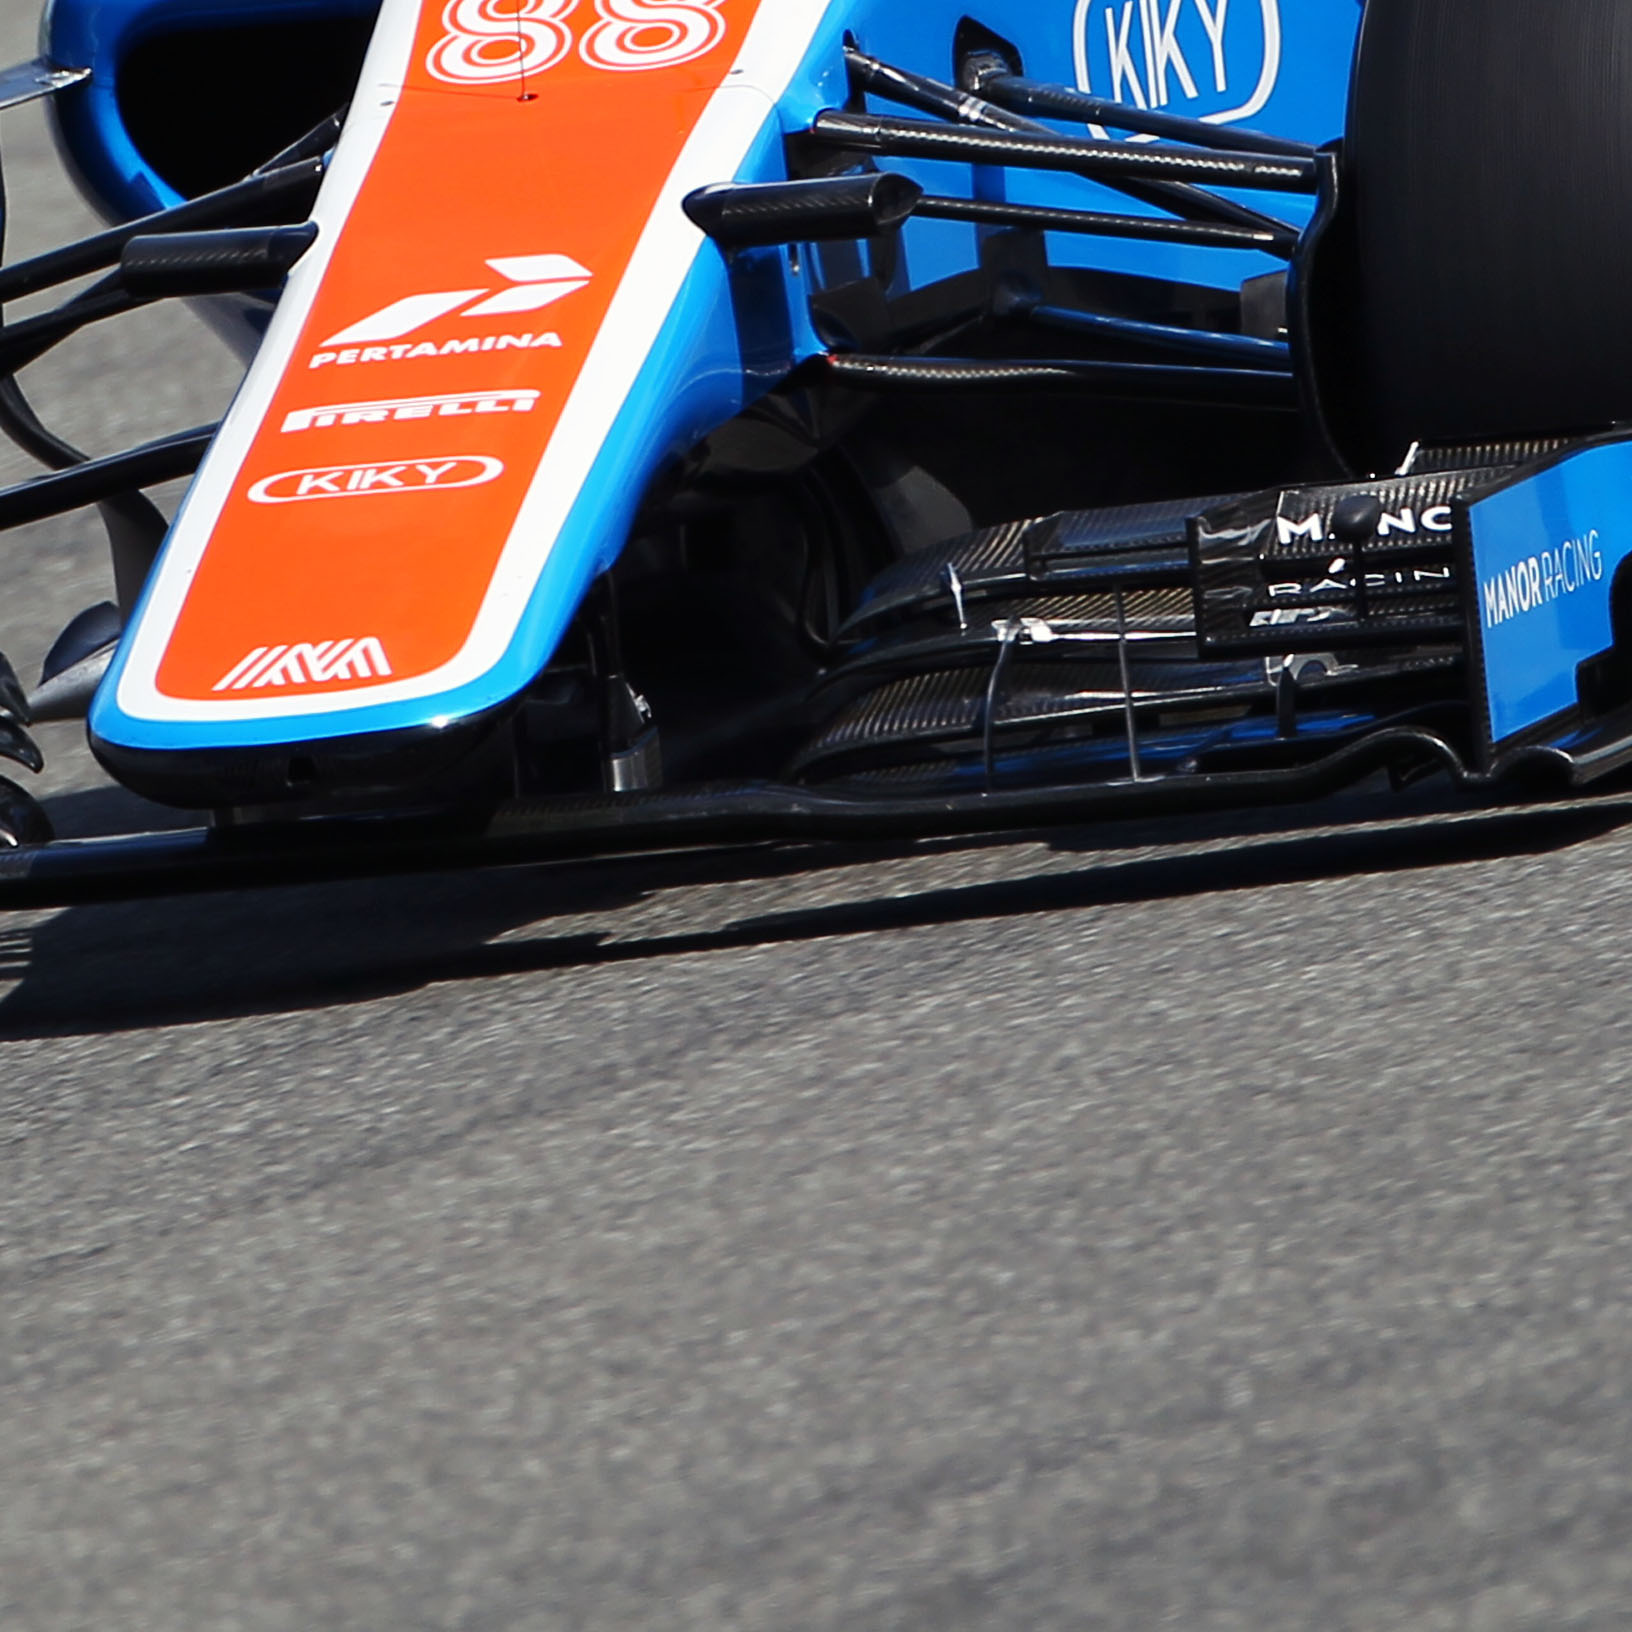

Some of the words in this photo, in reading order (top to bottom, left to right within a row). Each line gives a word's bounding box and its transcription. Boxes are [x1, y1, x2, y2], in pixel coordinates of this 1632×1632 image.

[308, 331, 564, 370] PERTAMINA
[279, 388, 542, 433] PIRELLI
[294, 462, 461, 495] KIKY
[1483, 556, 1544, 629] MANOR
[1540, 528, 1604, 603] RACING
